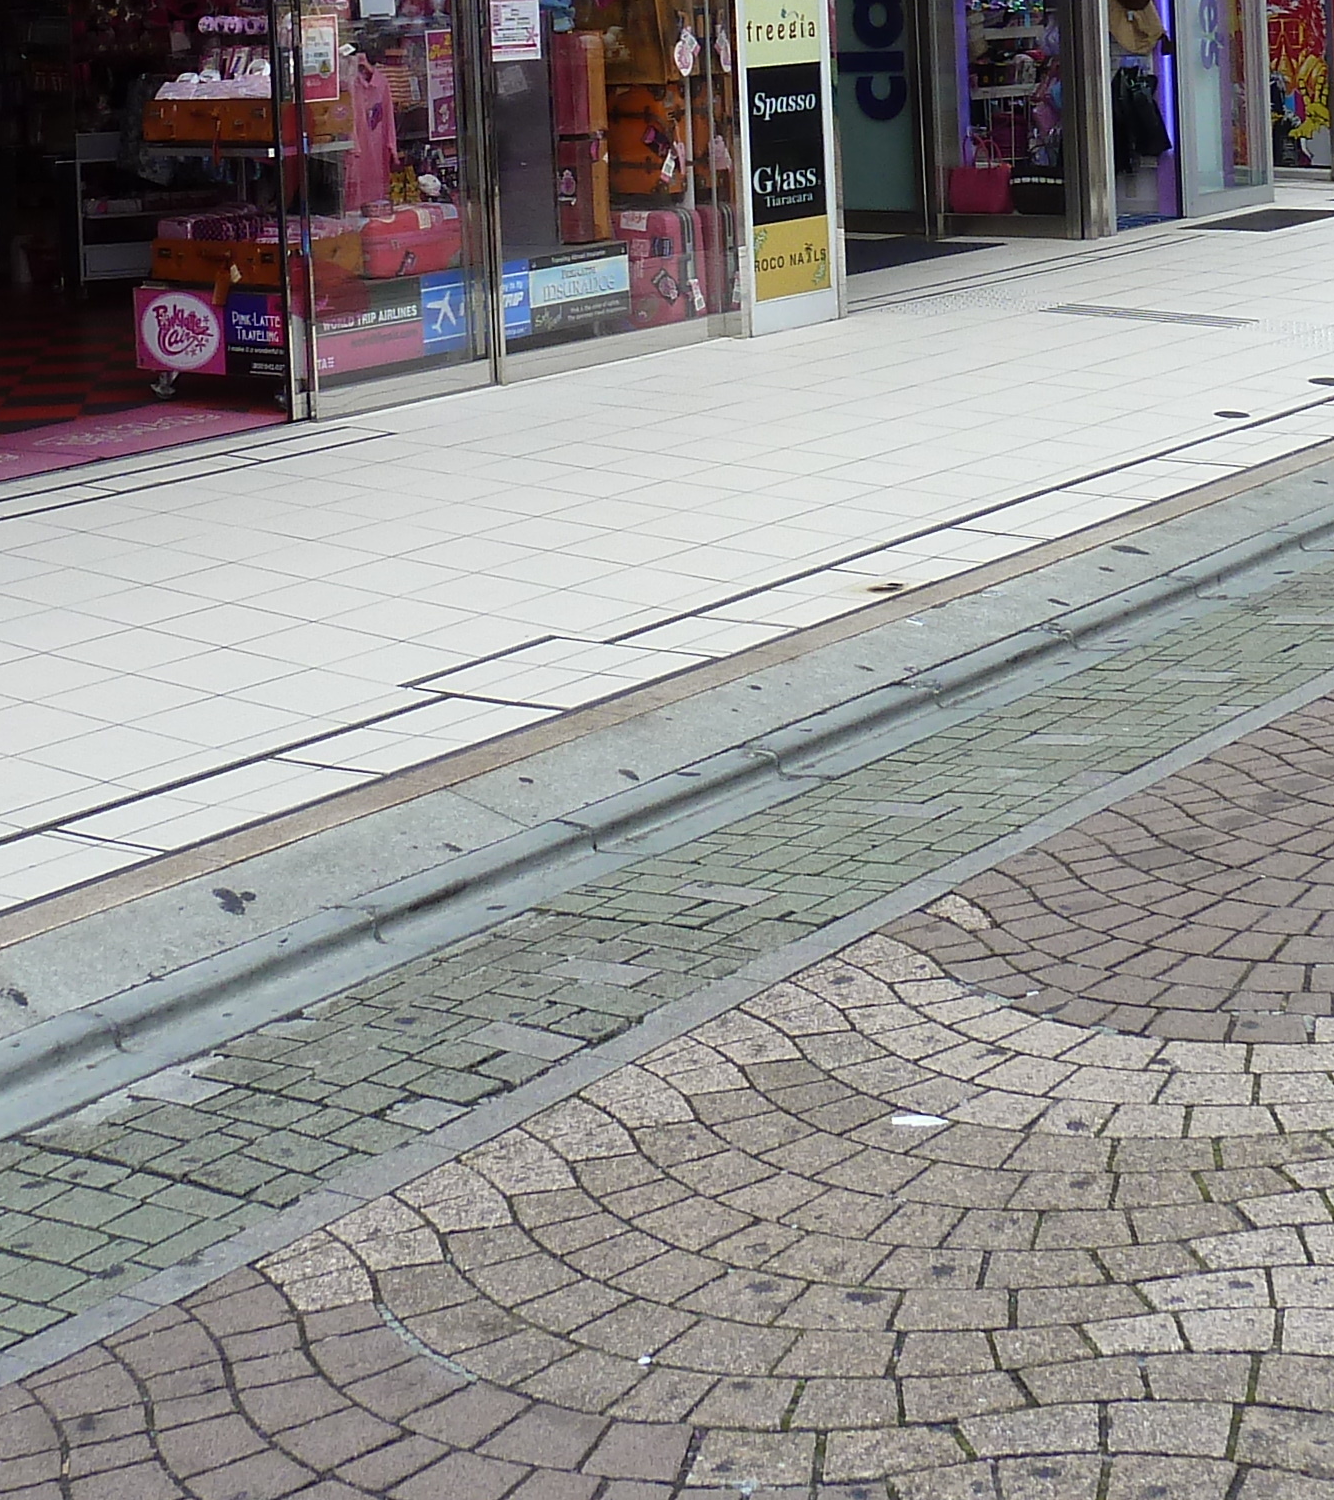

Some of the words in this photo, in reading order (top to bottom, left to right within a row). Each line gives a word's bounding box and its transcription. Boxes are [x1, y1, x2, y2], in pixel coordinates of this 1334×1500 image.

[746, 12, 817, 43] freegia
[752, 89, 817, 121] Spasso
[322, 315, 355, 332] WORLD
[356, 309, 377, 327] TRIP
[377, 304, 418, 323] AIRLINES
